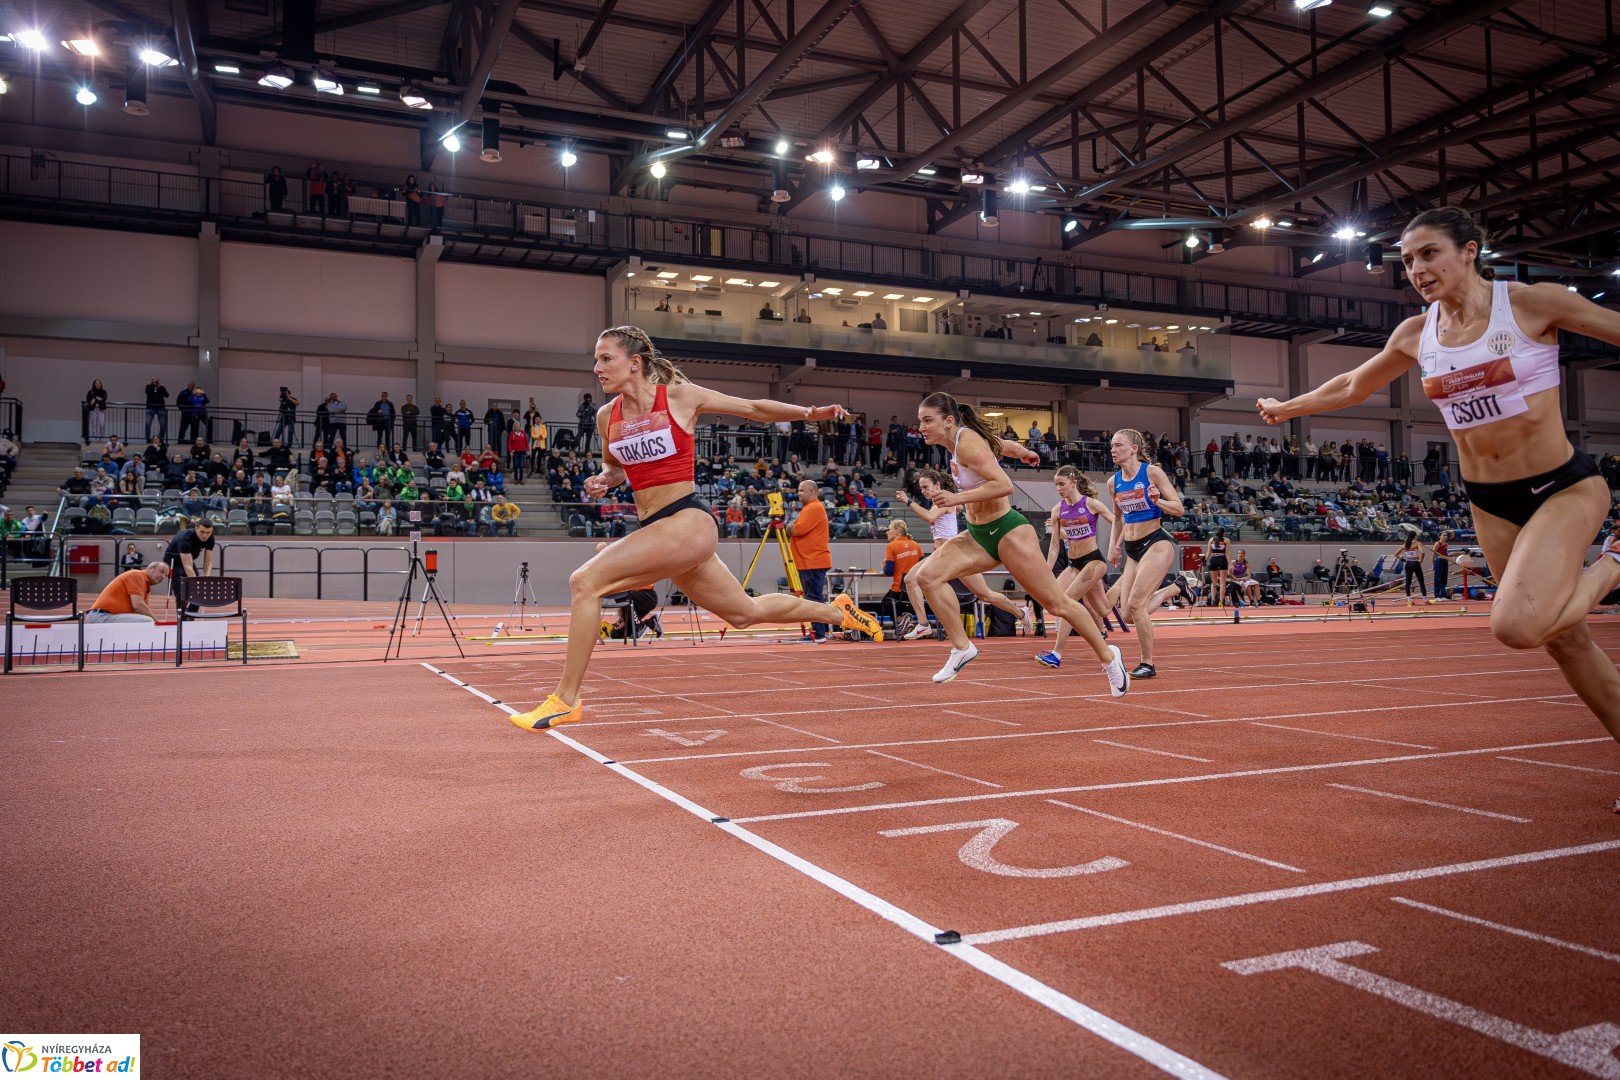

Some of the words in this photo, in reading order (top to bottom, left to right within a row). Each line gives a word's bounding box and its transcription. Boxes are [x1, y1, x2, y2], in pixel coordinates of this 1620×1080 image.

[1451, 394, 1502, 425] CSÓTI
[616, 436, 667, 463] TAKÁCS
[739, 762, 886, 793] 3
[876, 818, 1132, 878] 2
[1219, 940, 1620, 1080] 1
